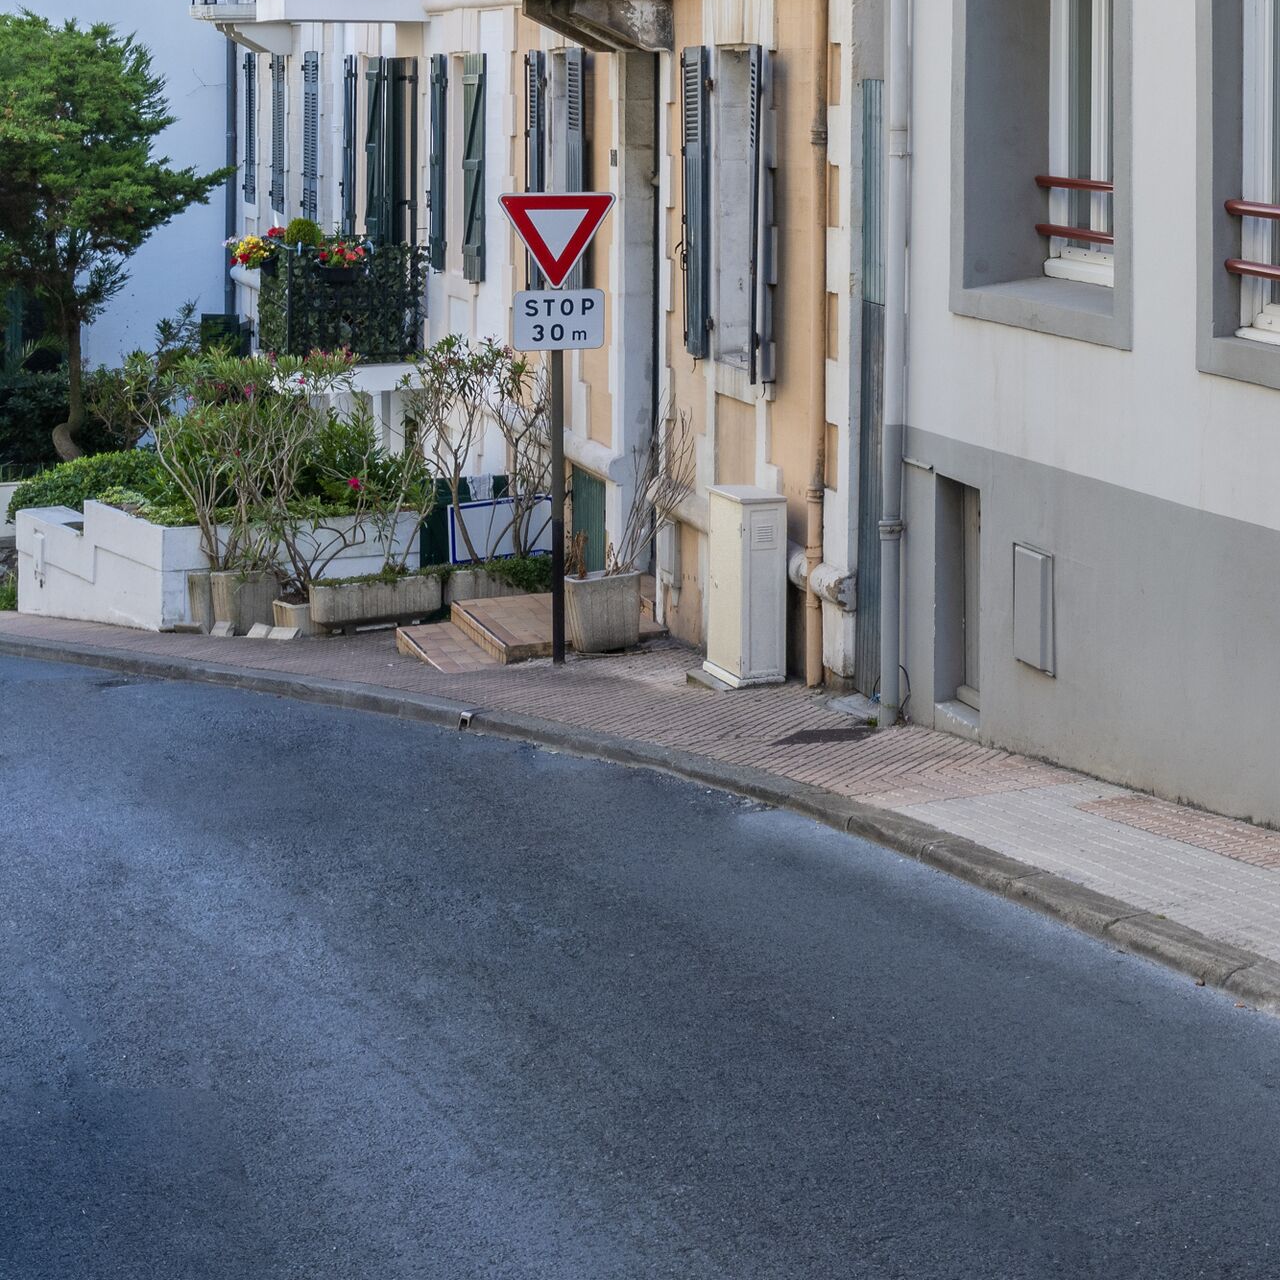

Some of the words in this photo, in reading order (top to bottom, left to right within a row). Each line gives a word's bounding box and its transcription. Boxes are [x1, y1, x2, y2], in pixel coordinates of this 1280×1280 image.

[524, 297, 595, 317] STOP
[532, 323, 564, 342] 30
[571, 329, 587, 341] m
